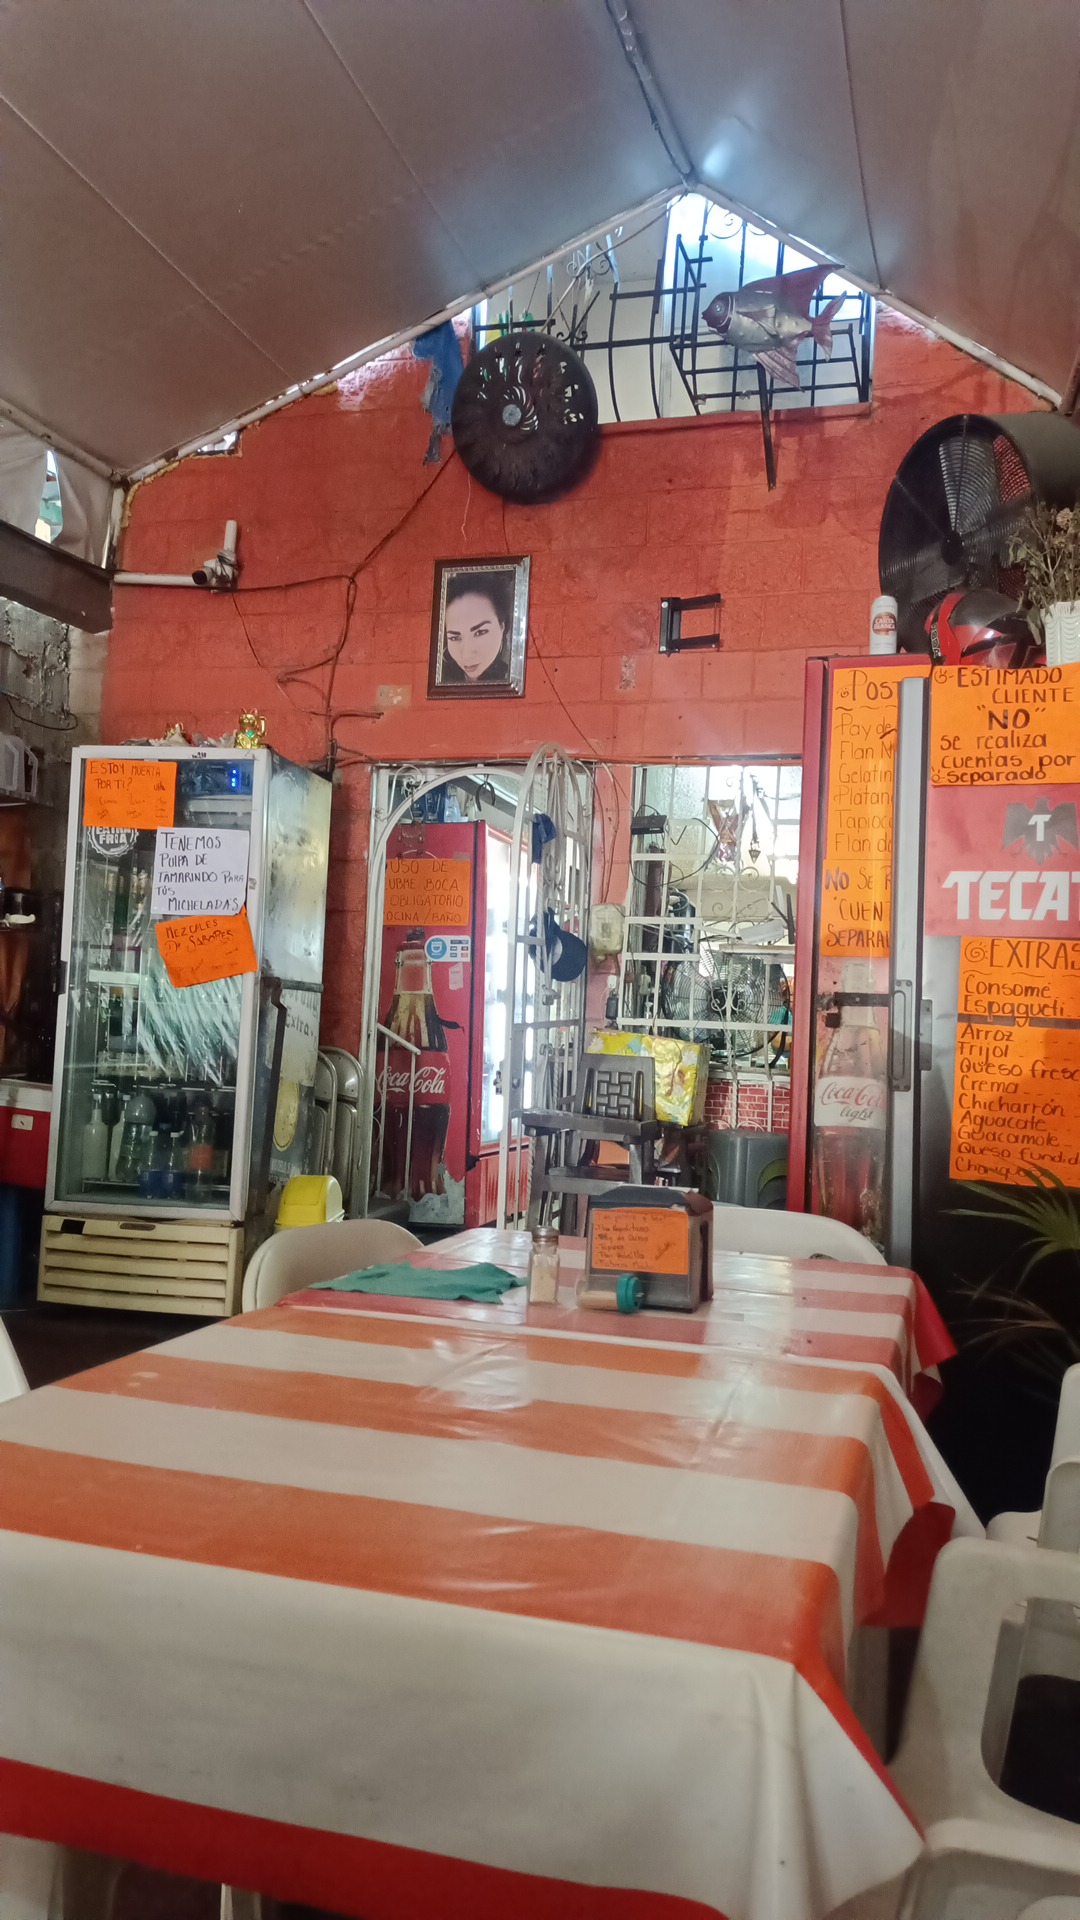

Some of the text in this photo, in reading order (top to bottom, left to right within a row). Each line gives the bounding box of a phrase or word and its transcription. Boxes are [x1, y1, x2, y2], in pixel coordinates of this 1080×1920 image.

[957, 667, 1063, 688] ESTIMADO
[992, 687, 1075, 704] CLIENTE
[834, 712, 872, 742] Pay
[976, 730, 1047, 750] realiza
[840, 741, 875, 760] Flan
[90, 760, 126, 775] ESTOY
[941, 751, 1077, 772] cuentas por
[99, 833, 128, 845] FRIA
[160, 831, 222, 852] TENEMOS
[835, 832, 871, 852] Flan
[195, 853, 208, 866] DE
[390, 860, 448, 874] USO DE
[158, 871, 218, 883] TAMARINDO
[386, 877, 459, 892] UBRE BOCA
[825, 866, 850, 892] NO
[389, 894, 464, 908] OBLIGATORIO
[384, 910, 419, 922] OCINA
[826, 923, 891, 949] SEPARA
[965, 974, 1052, 999] Consomé
[963, 994, 1065, 1028] Espagueti
[960, 1022, 1014, 1042] Arroz
[960, 1058, 1023, 1077] Queso
[960, 1075, 1019, 1094] Crema
[840, 1106, 874, 1122] light
[959, 1110, 1047, 1133] Aguacate
[957, 1124, 1060, 1147] Guacamole
[958, 1142, 1011, 1159] Queso
